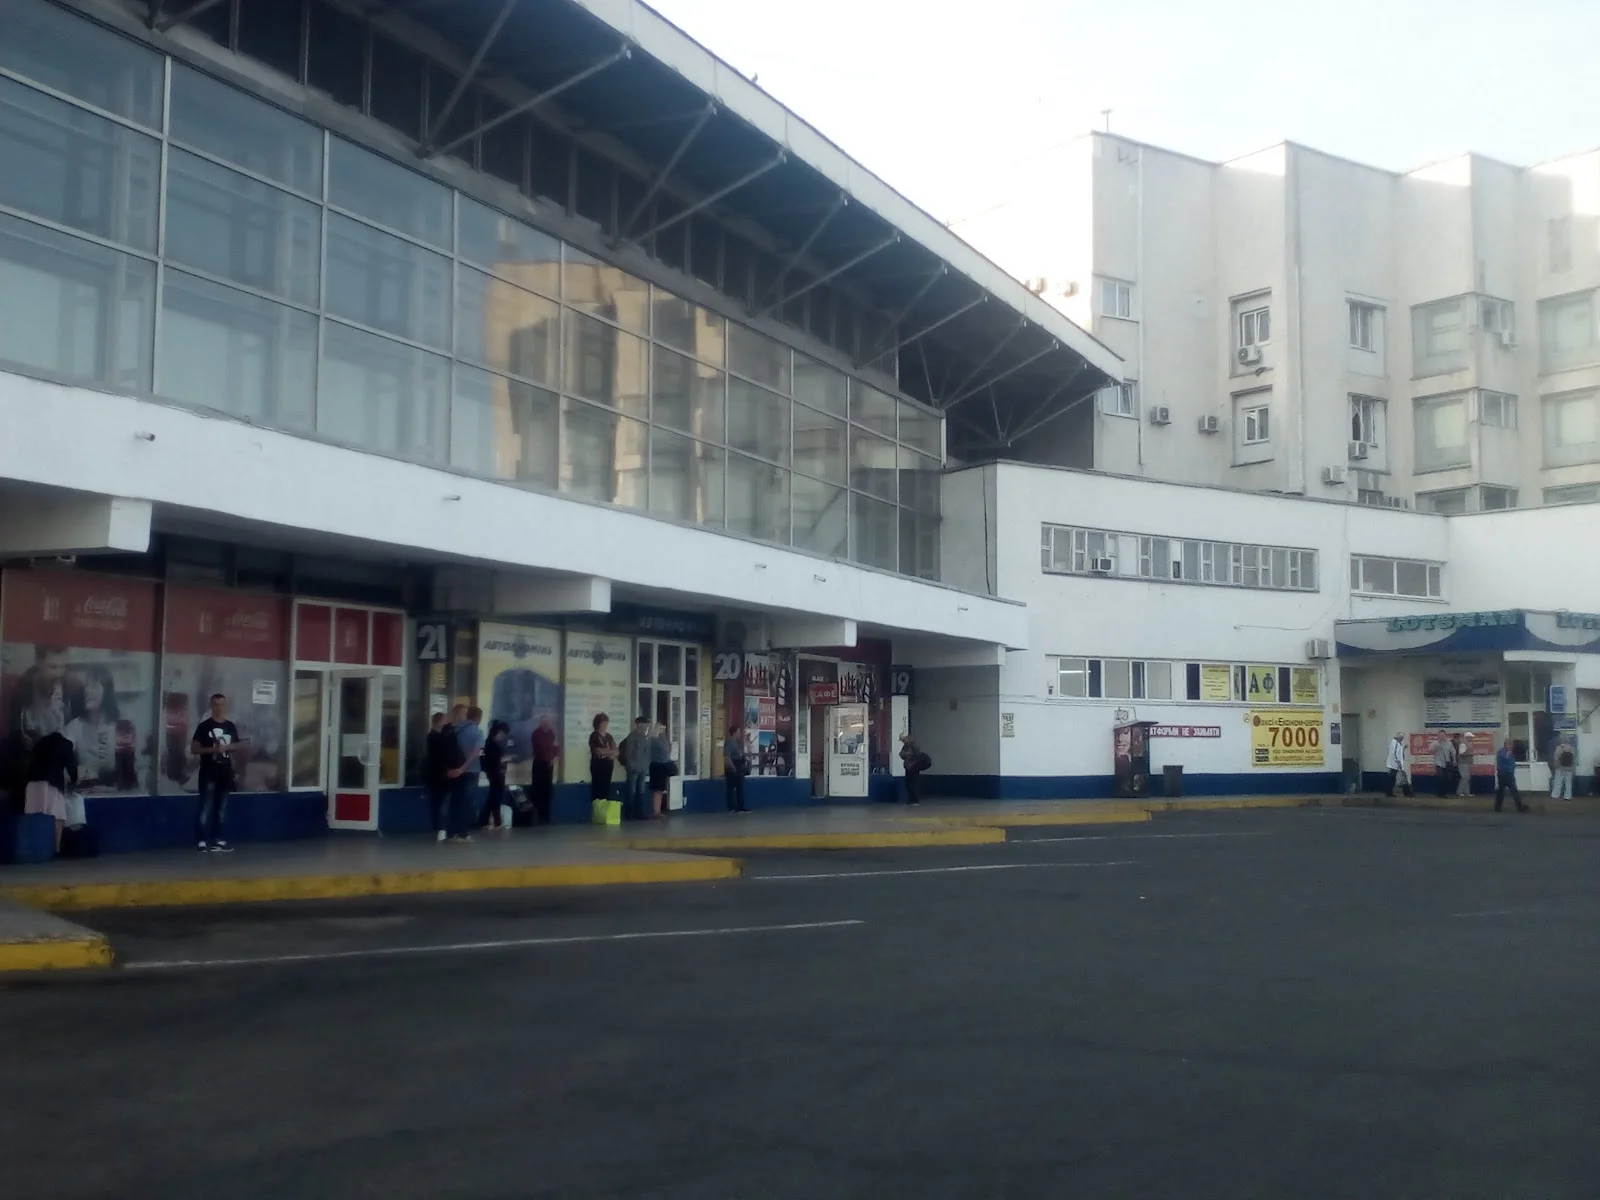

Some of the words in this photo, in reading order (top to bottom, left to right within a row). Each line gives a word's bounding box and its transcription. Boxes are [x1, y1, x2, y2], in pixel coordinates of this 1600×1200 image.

[418, 624, 447, 659] 21
[714, 653, 741, 680] 20
[891, 671, 910, 694] 19
[1268, 727, 1320, 748] 7000
